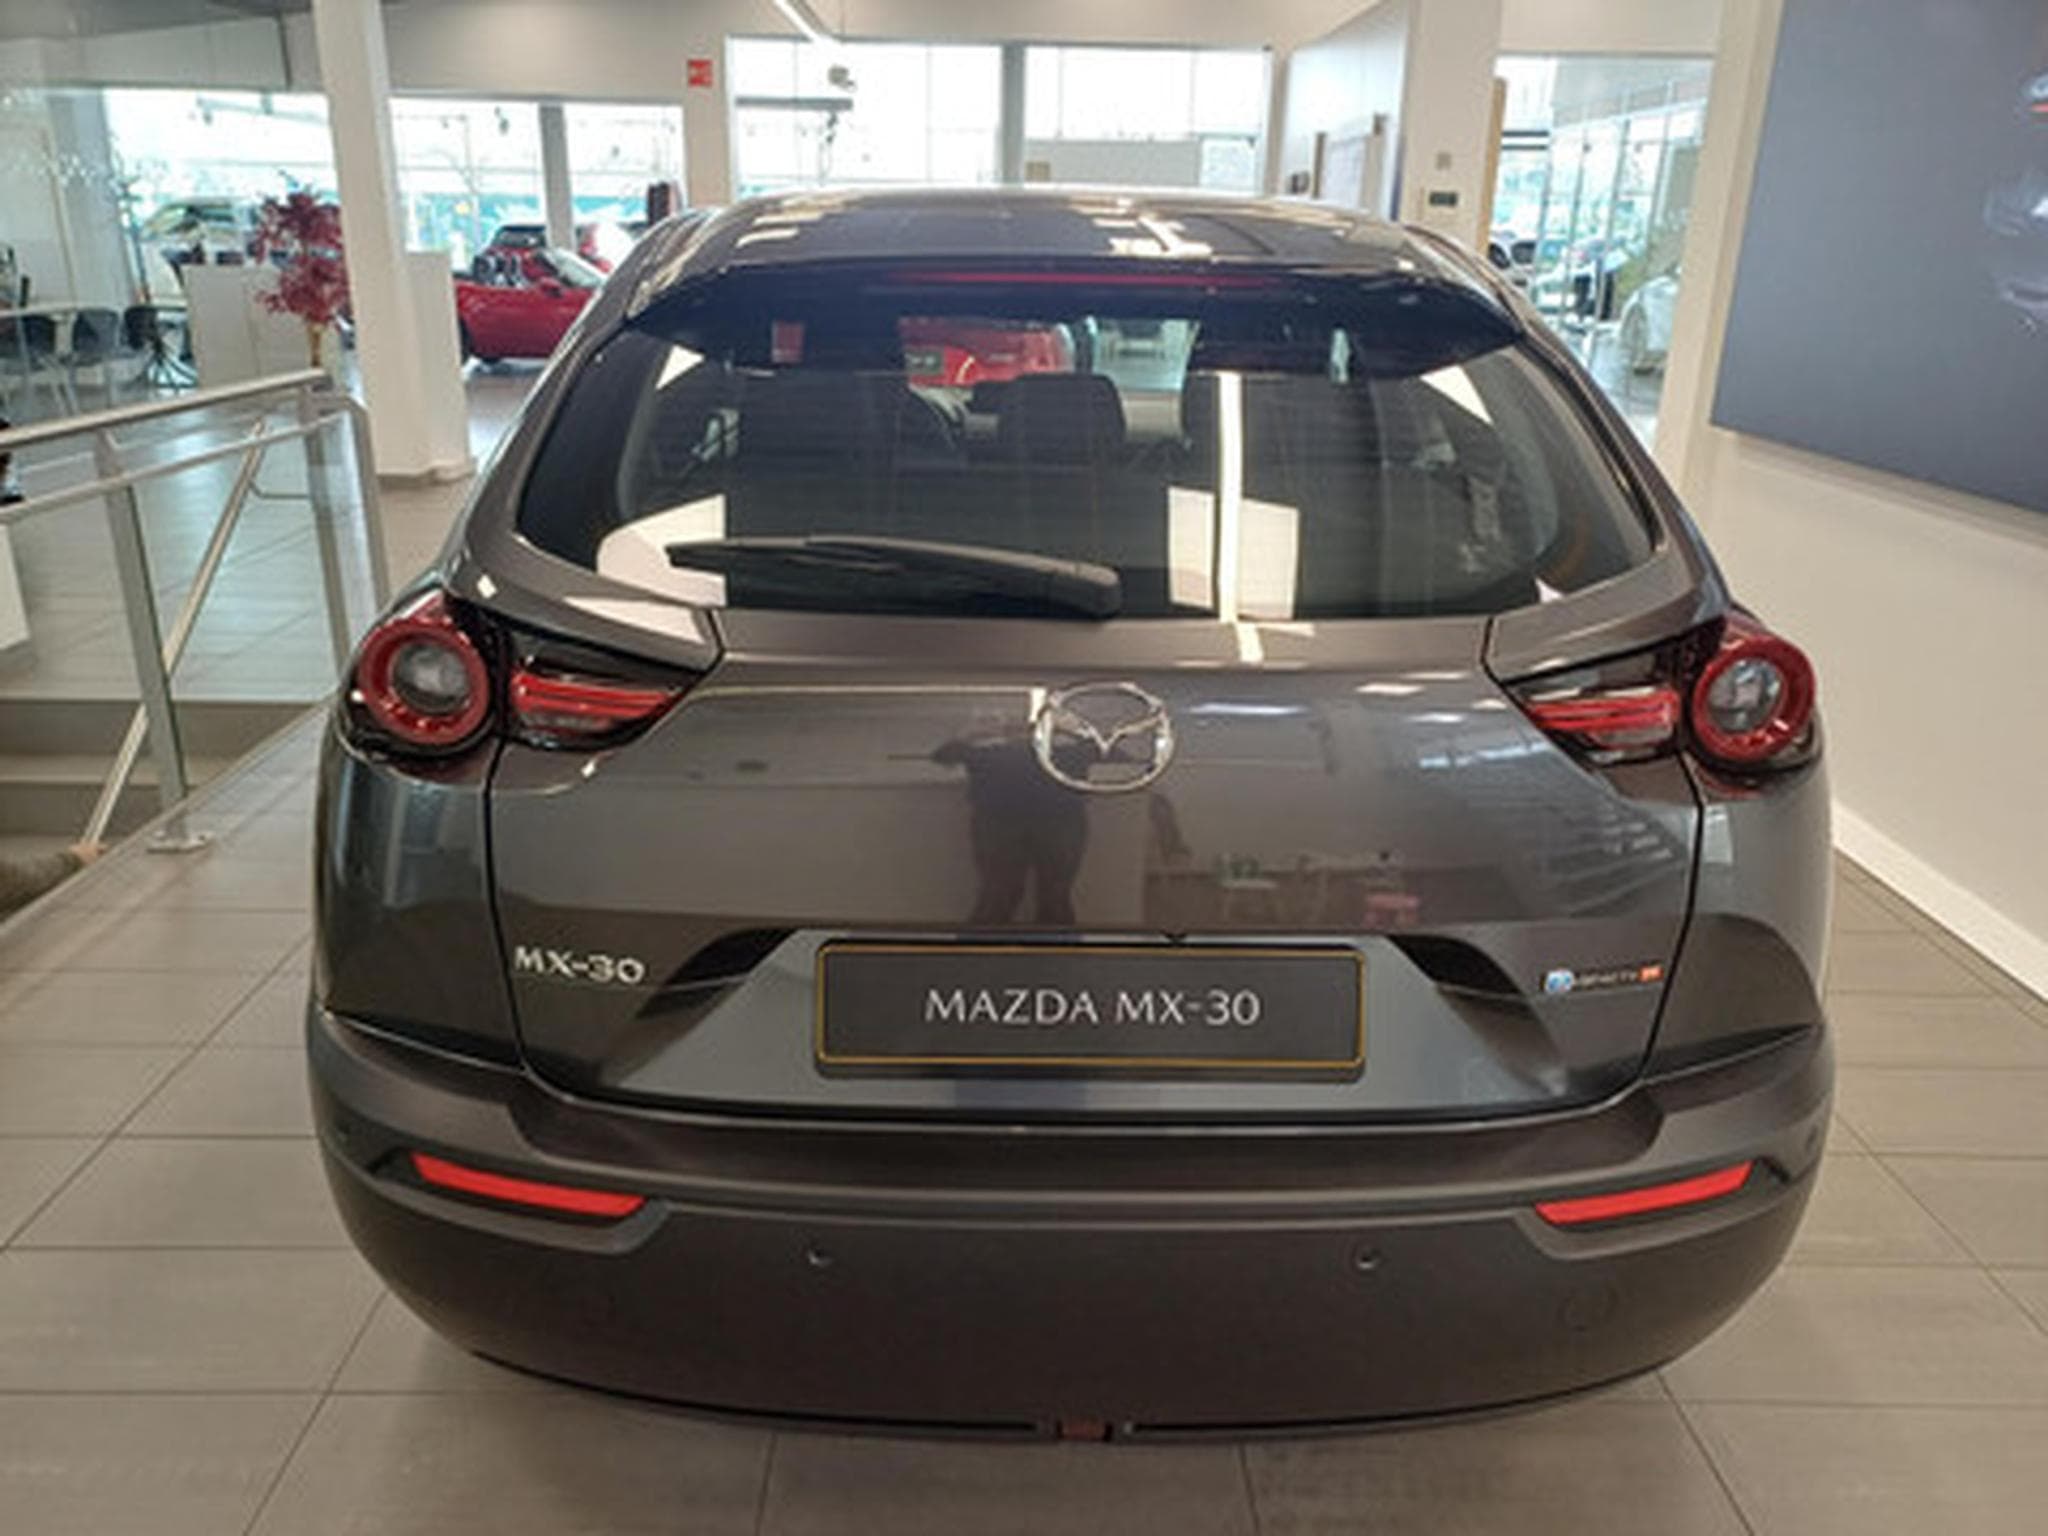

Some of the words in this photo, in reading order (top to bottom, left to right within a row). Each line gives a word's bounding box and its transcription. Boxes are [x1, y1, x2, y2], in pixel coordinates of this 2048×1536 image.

[514, 945, 646, 985] MX-30
[925, 988, 1099, 1025] MAZDA
[1115, 988, 1261, 1026] MX-30
